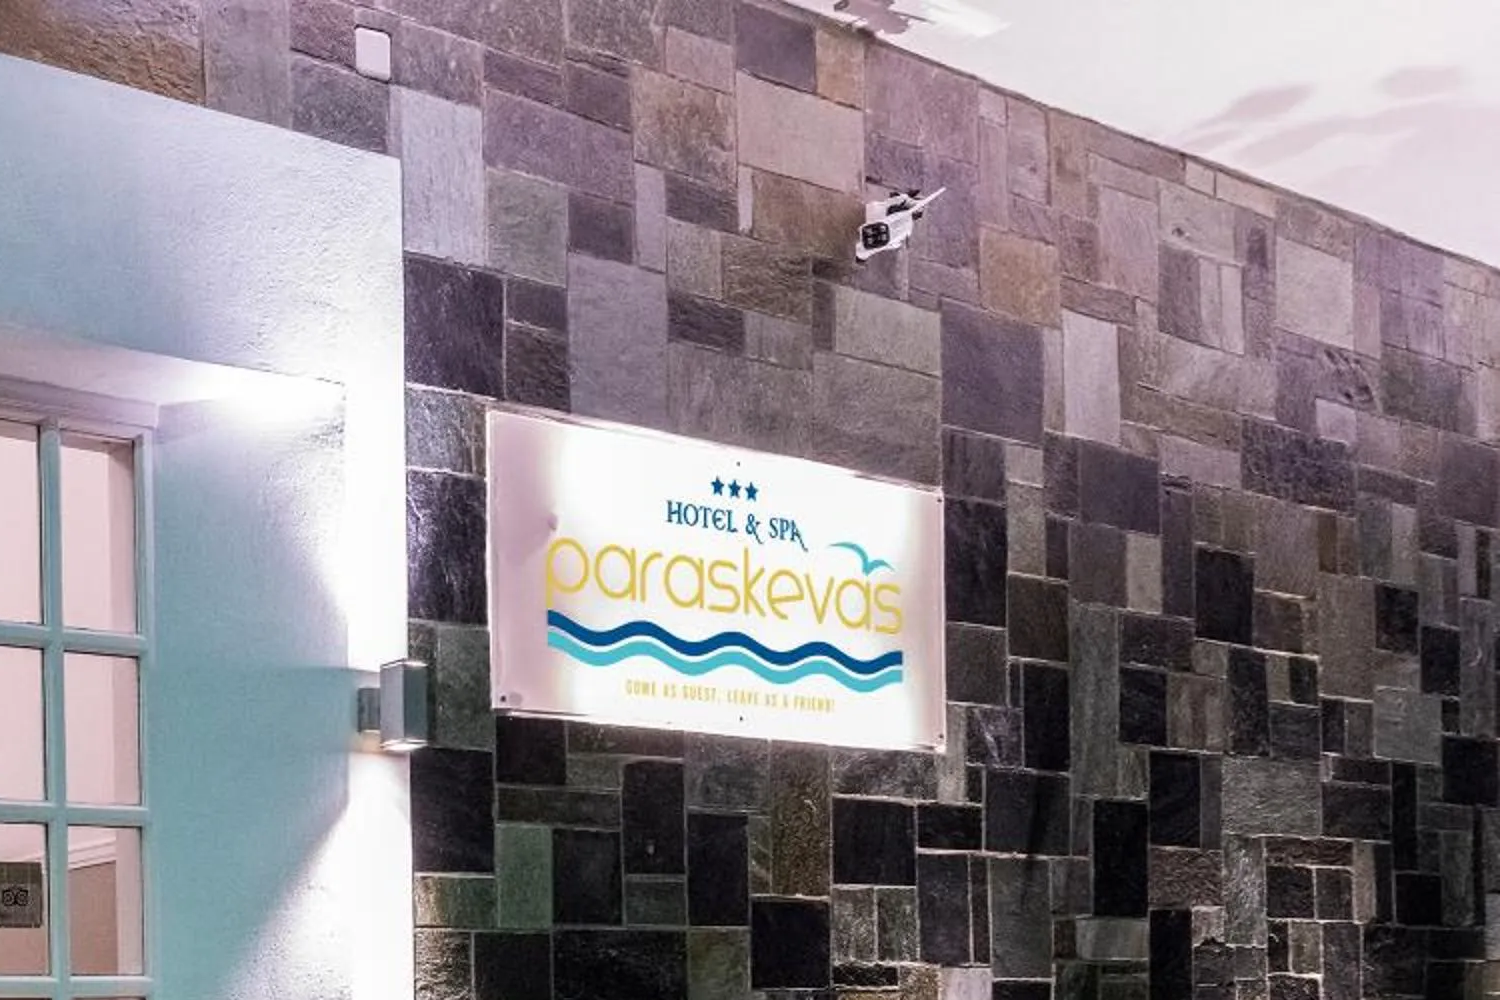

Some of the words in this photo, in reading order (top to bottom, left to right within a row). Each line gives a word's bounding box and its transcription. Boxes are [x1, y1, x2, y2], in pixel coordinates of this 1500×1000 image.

[666, 500, 738, 533] HOTEL
[745, 513, 764, 545] &
[768, 517, 808, 552] SPA
[546, 537, 902, 635] paraskevas
